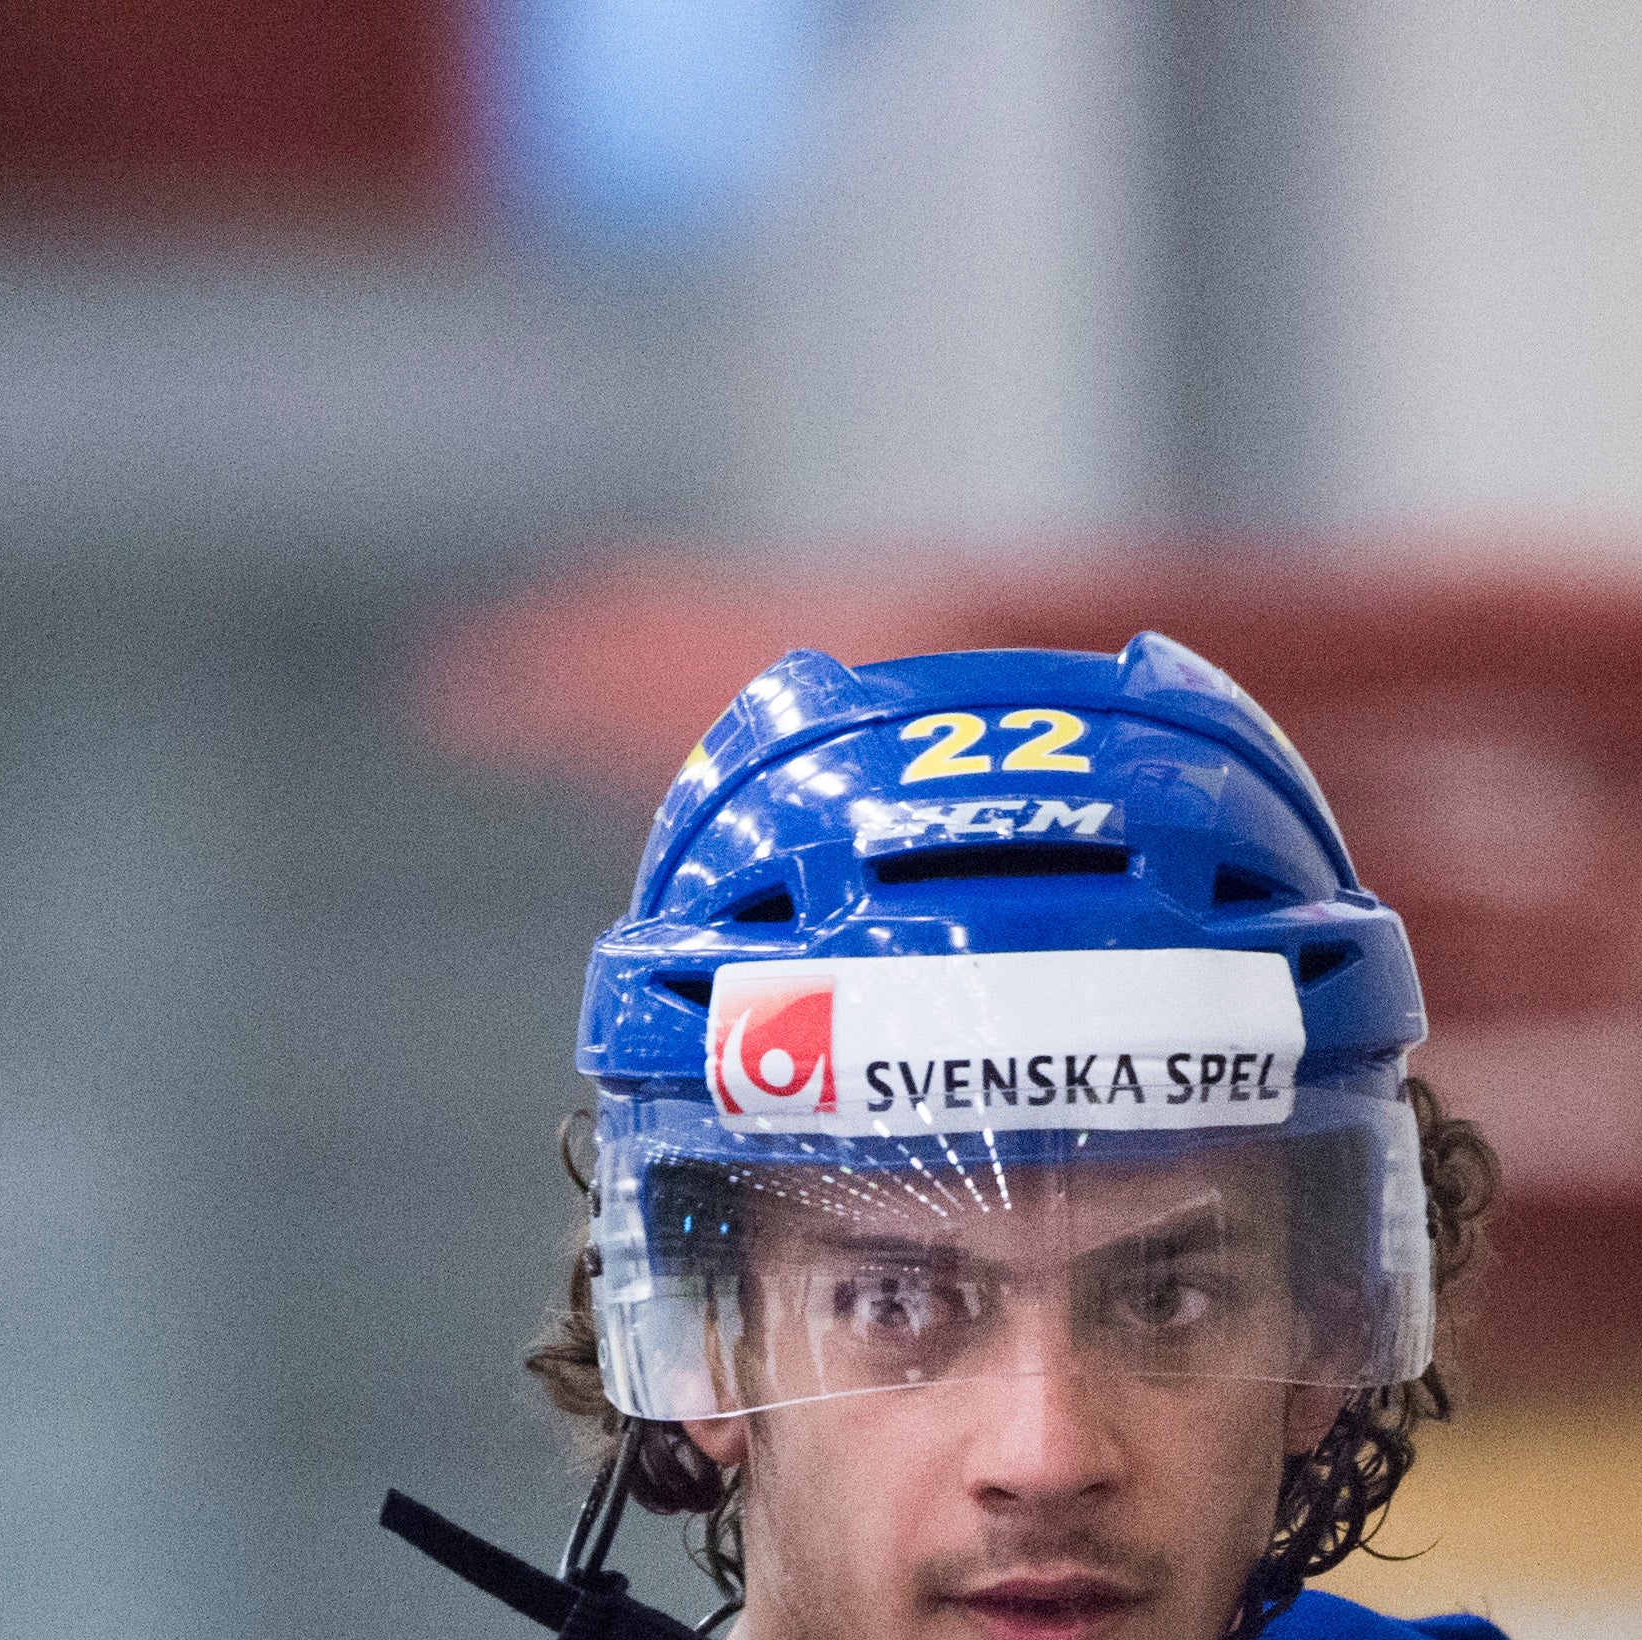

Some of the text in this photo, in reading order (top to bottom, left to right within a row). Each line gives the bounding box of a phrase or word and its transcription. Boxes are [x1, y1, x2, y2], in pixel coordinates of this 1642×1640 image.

[900, 708, 1092, 786] 22
[865, 1053, 1280, 1112] SVENSKA SPEL
